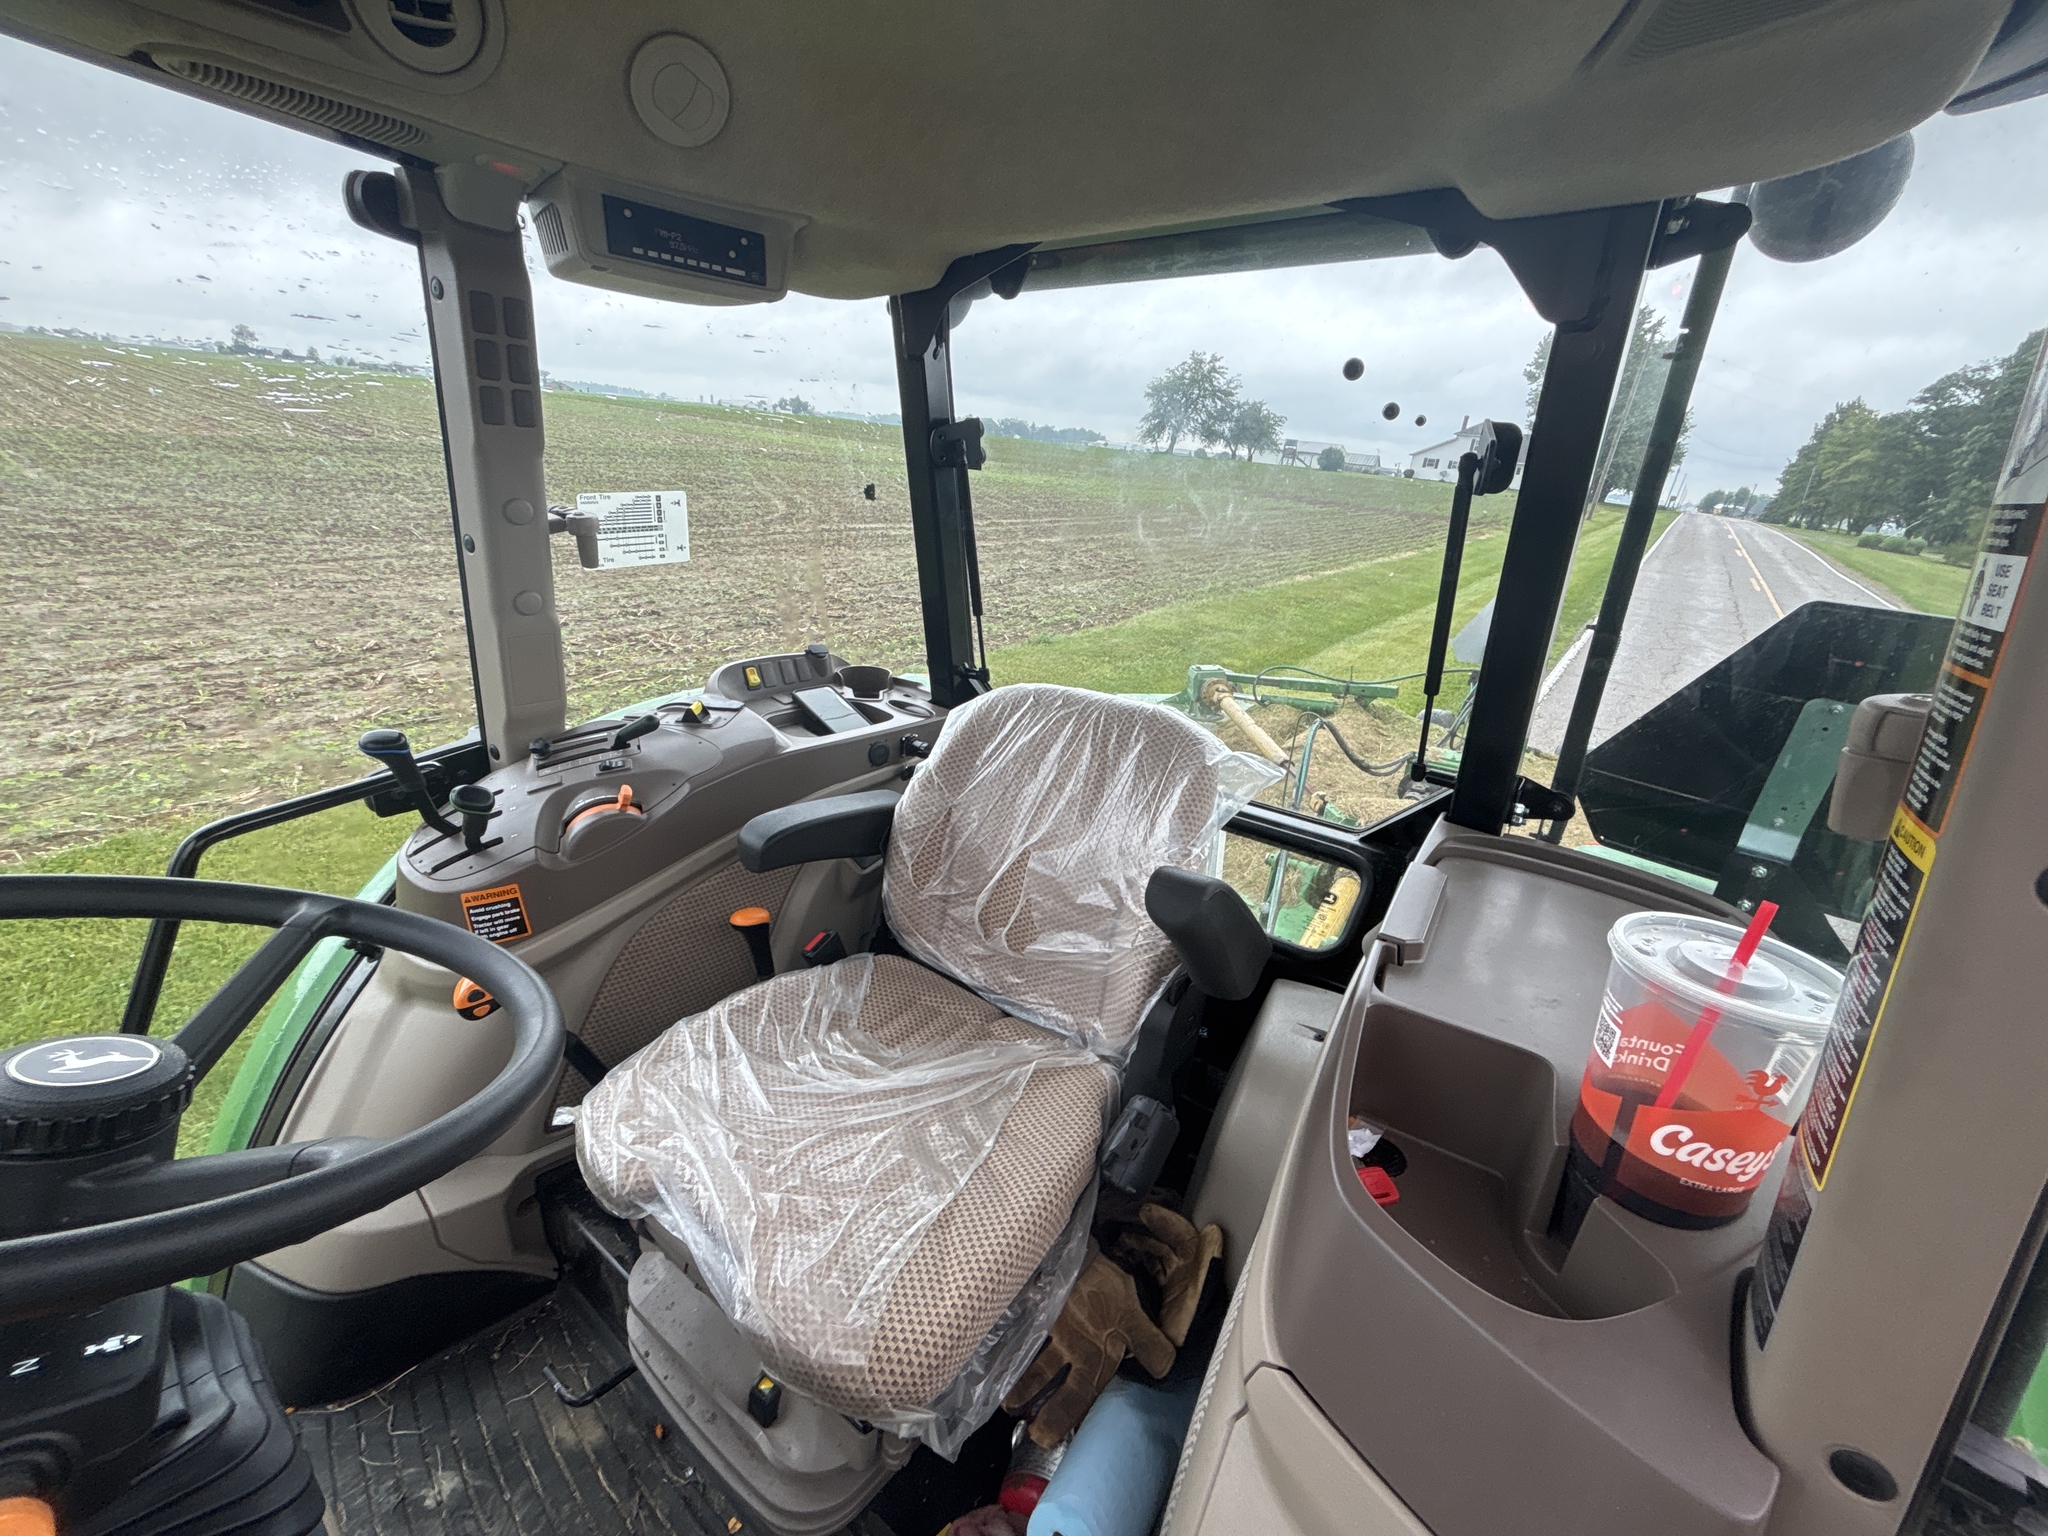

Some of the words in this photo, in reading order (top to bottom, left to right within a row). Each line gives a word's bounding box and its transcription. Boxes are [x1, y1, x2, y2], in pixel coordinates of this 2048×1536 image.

[1995, 563, 2013, 578] USE
[1986, 583, 2009, 599] SEAT
[1980, 603, 2002, 619] BELT
[470, 887, 518, 902] WARNING
[485, 902, 511, 911] crushing
[473, 921, 493, 929] Tractor
[504, 915, 520, 923] move
[491, 911, 504, 919] park
[488, 930, 508, 938] engine
[496, 924, 510, 932] gear
[1679, 1177, 1713, 1192] EXTRA
